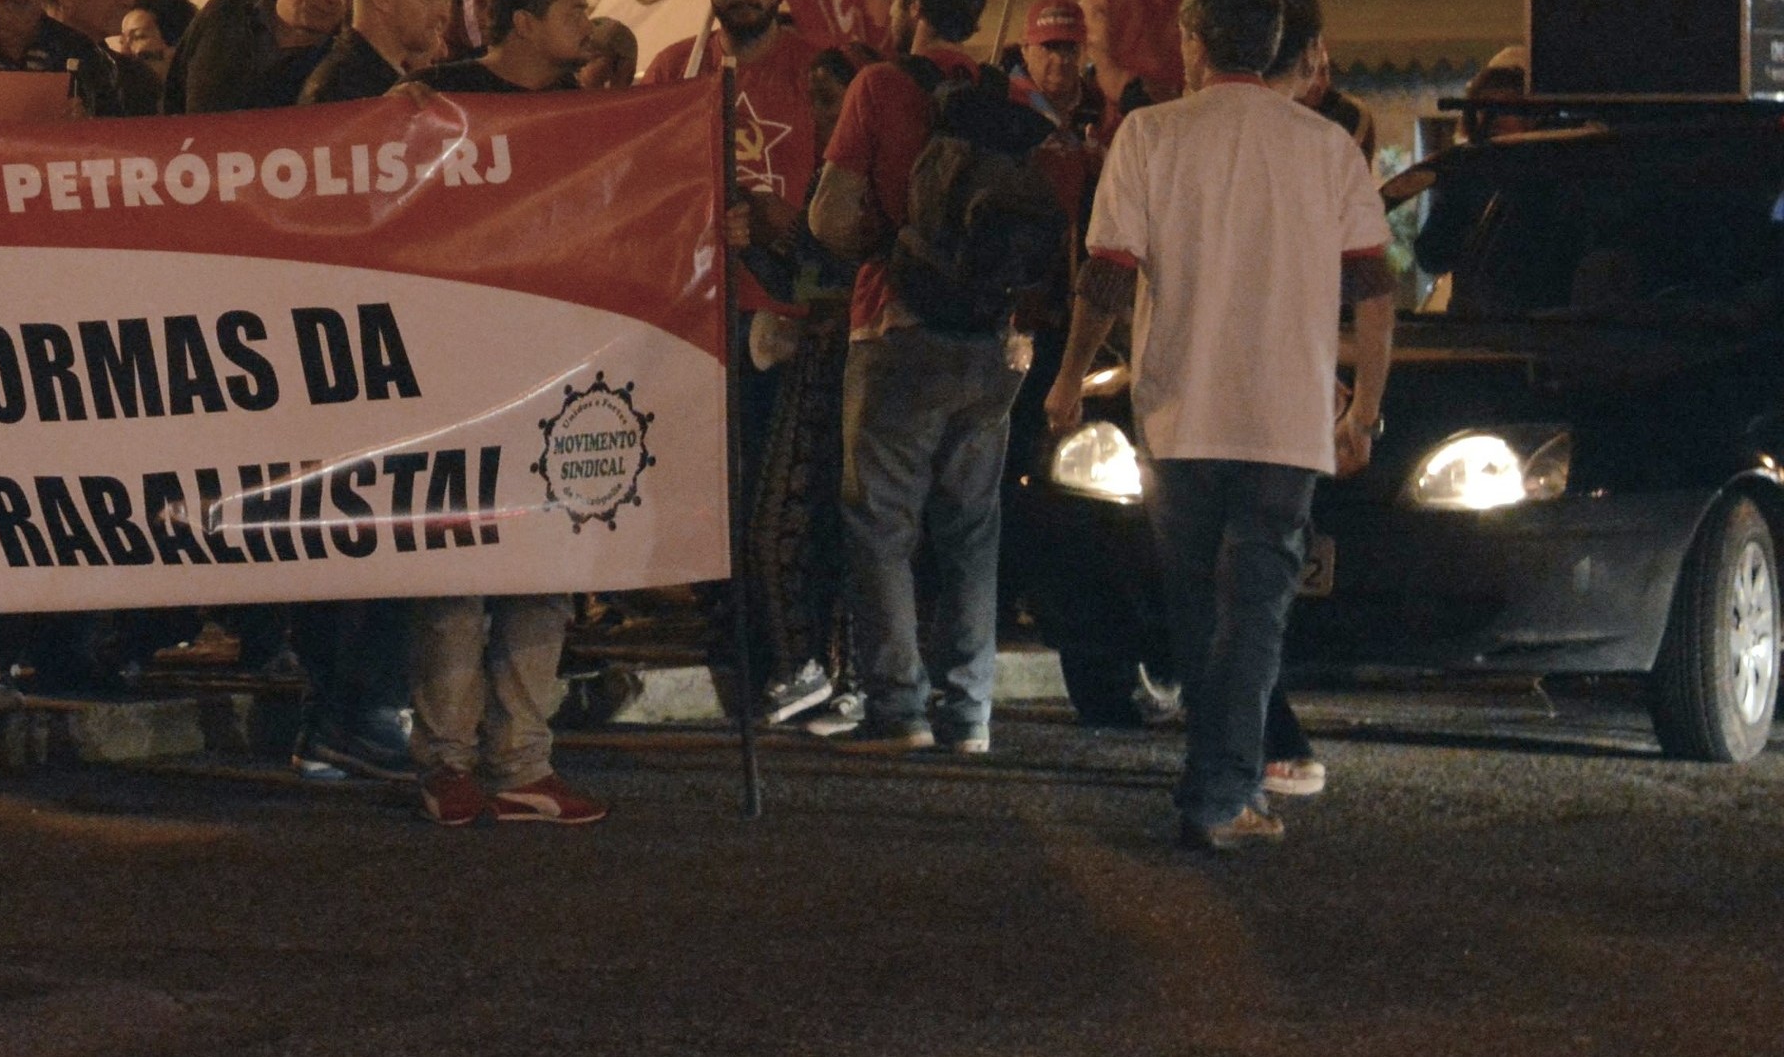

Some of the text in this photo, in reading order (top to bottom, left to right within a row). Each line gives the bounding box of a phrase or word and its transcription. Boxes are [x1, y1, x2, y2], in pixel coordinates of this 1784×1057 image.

[291, 302, 422, 405] DA
[553, 430, 637, 455] MOVIMENTO
[560, 456, 626, 480] SINDICAL
